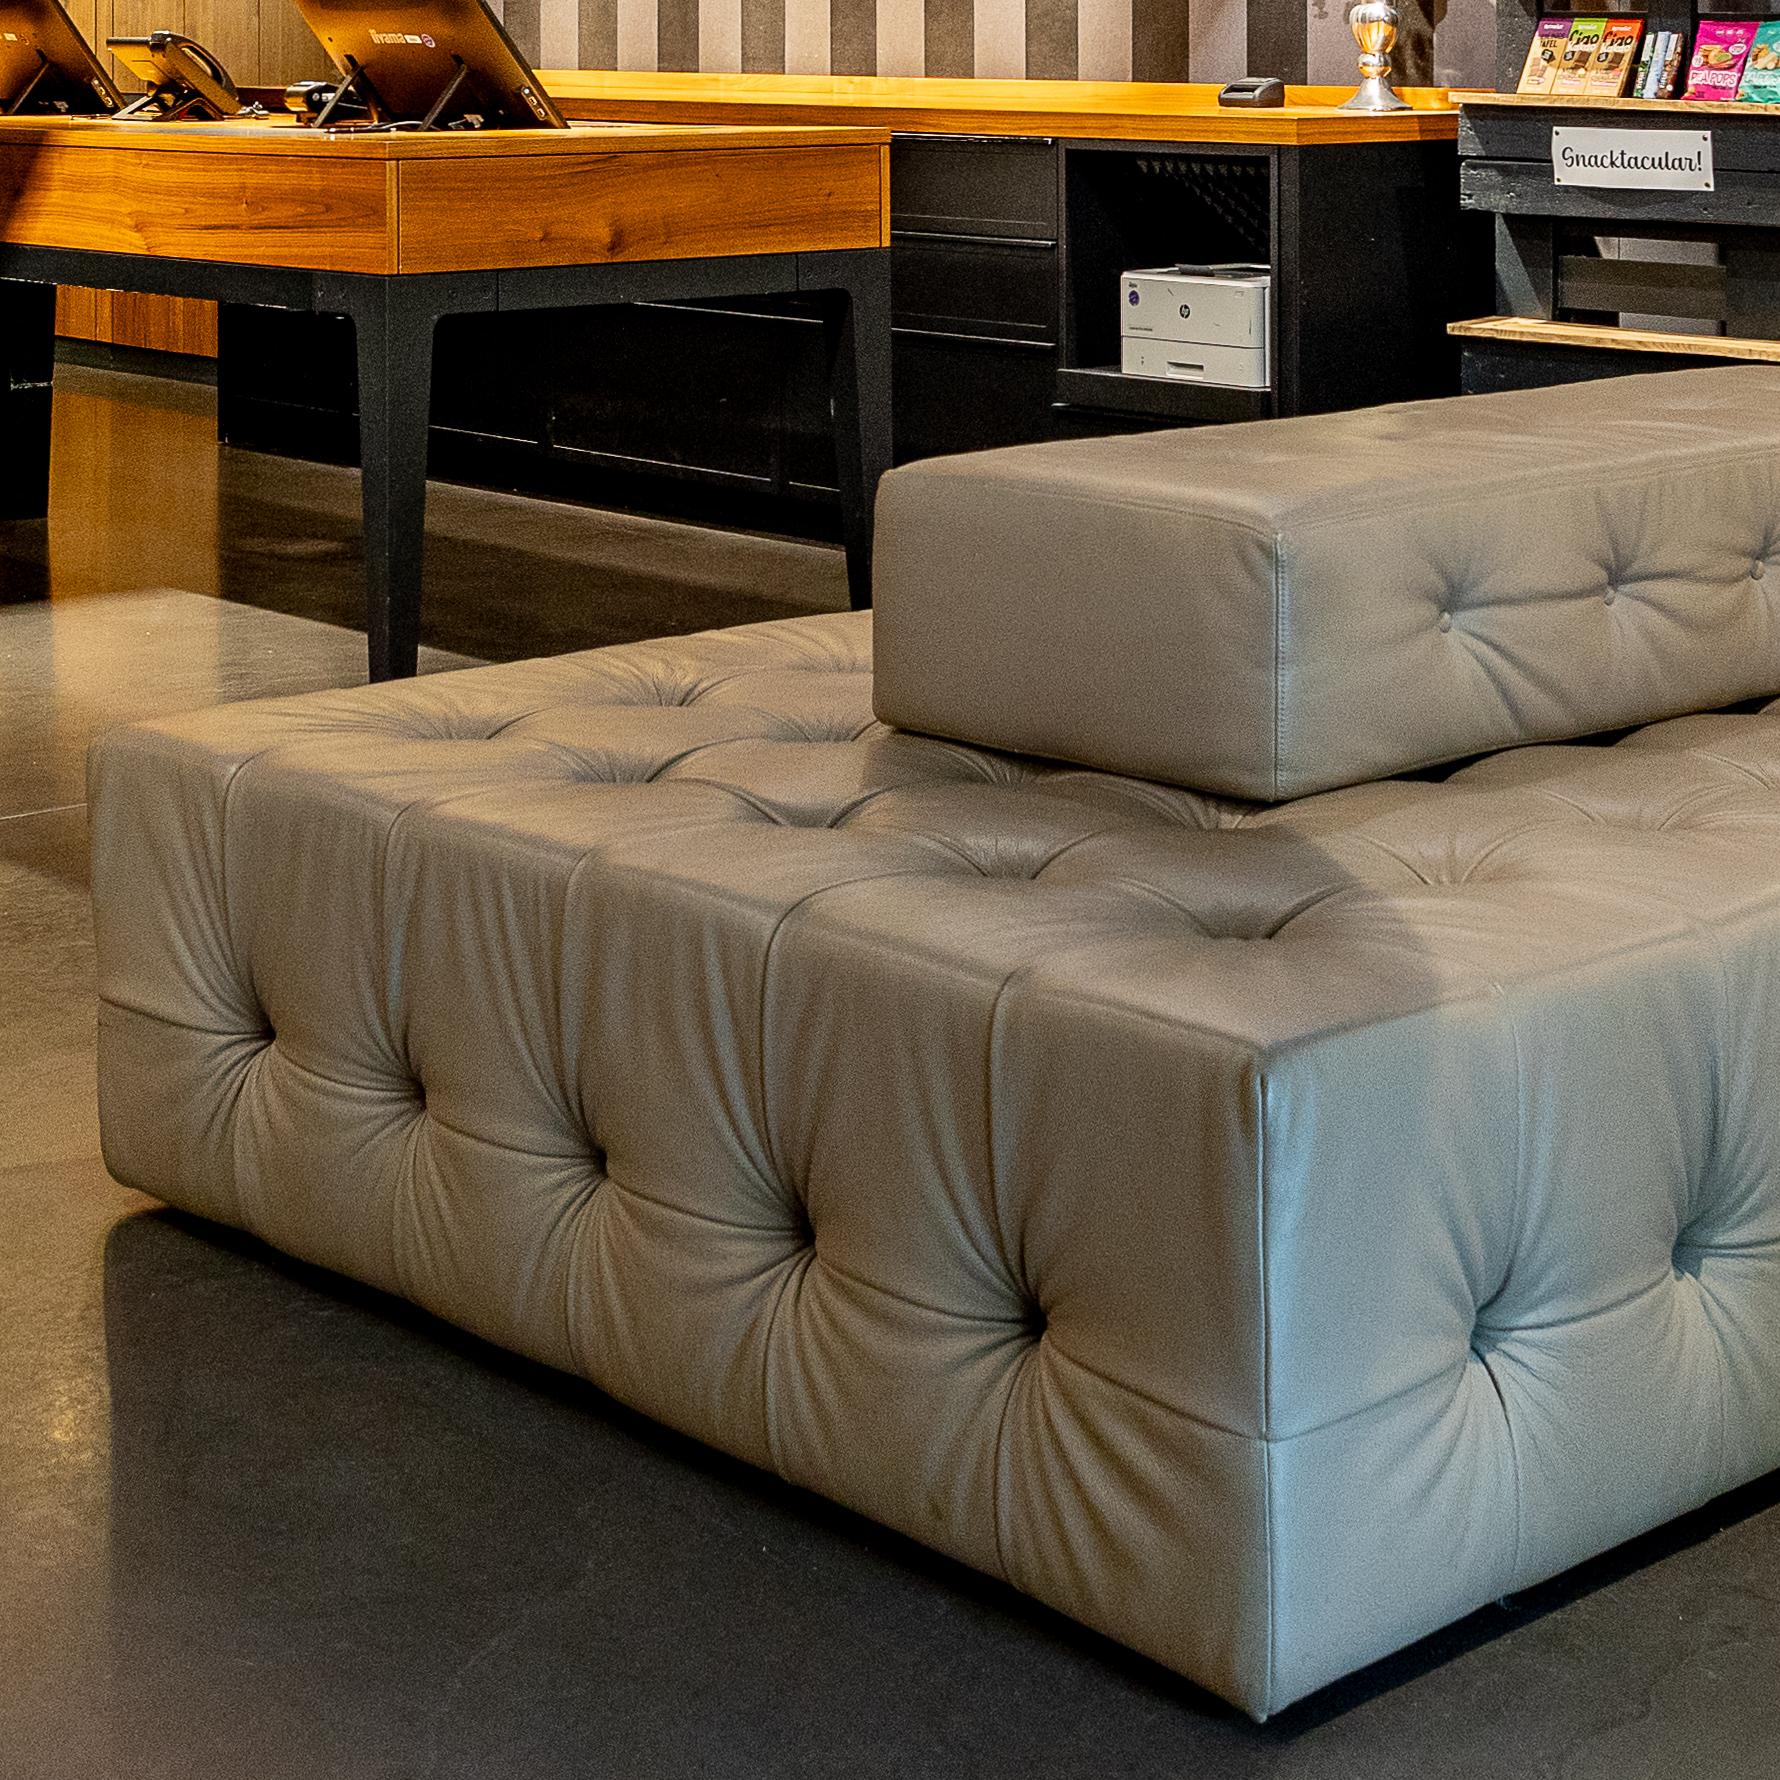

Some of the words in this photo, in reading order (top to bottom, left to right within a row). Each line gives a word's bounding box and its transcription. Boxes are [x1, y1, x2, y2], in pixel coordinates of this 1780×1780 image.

[1569, 30, 1599, 46] Ciao
[1603, 31, 1633, 47] Ciao
[1690, 71, 1709, 85] PEA
[1711, 72, 1738, 88] POPS
[1561, 146, 1702, 172] Snacktacular!
